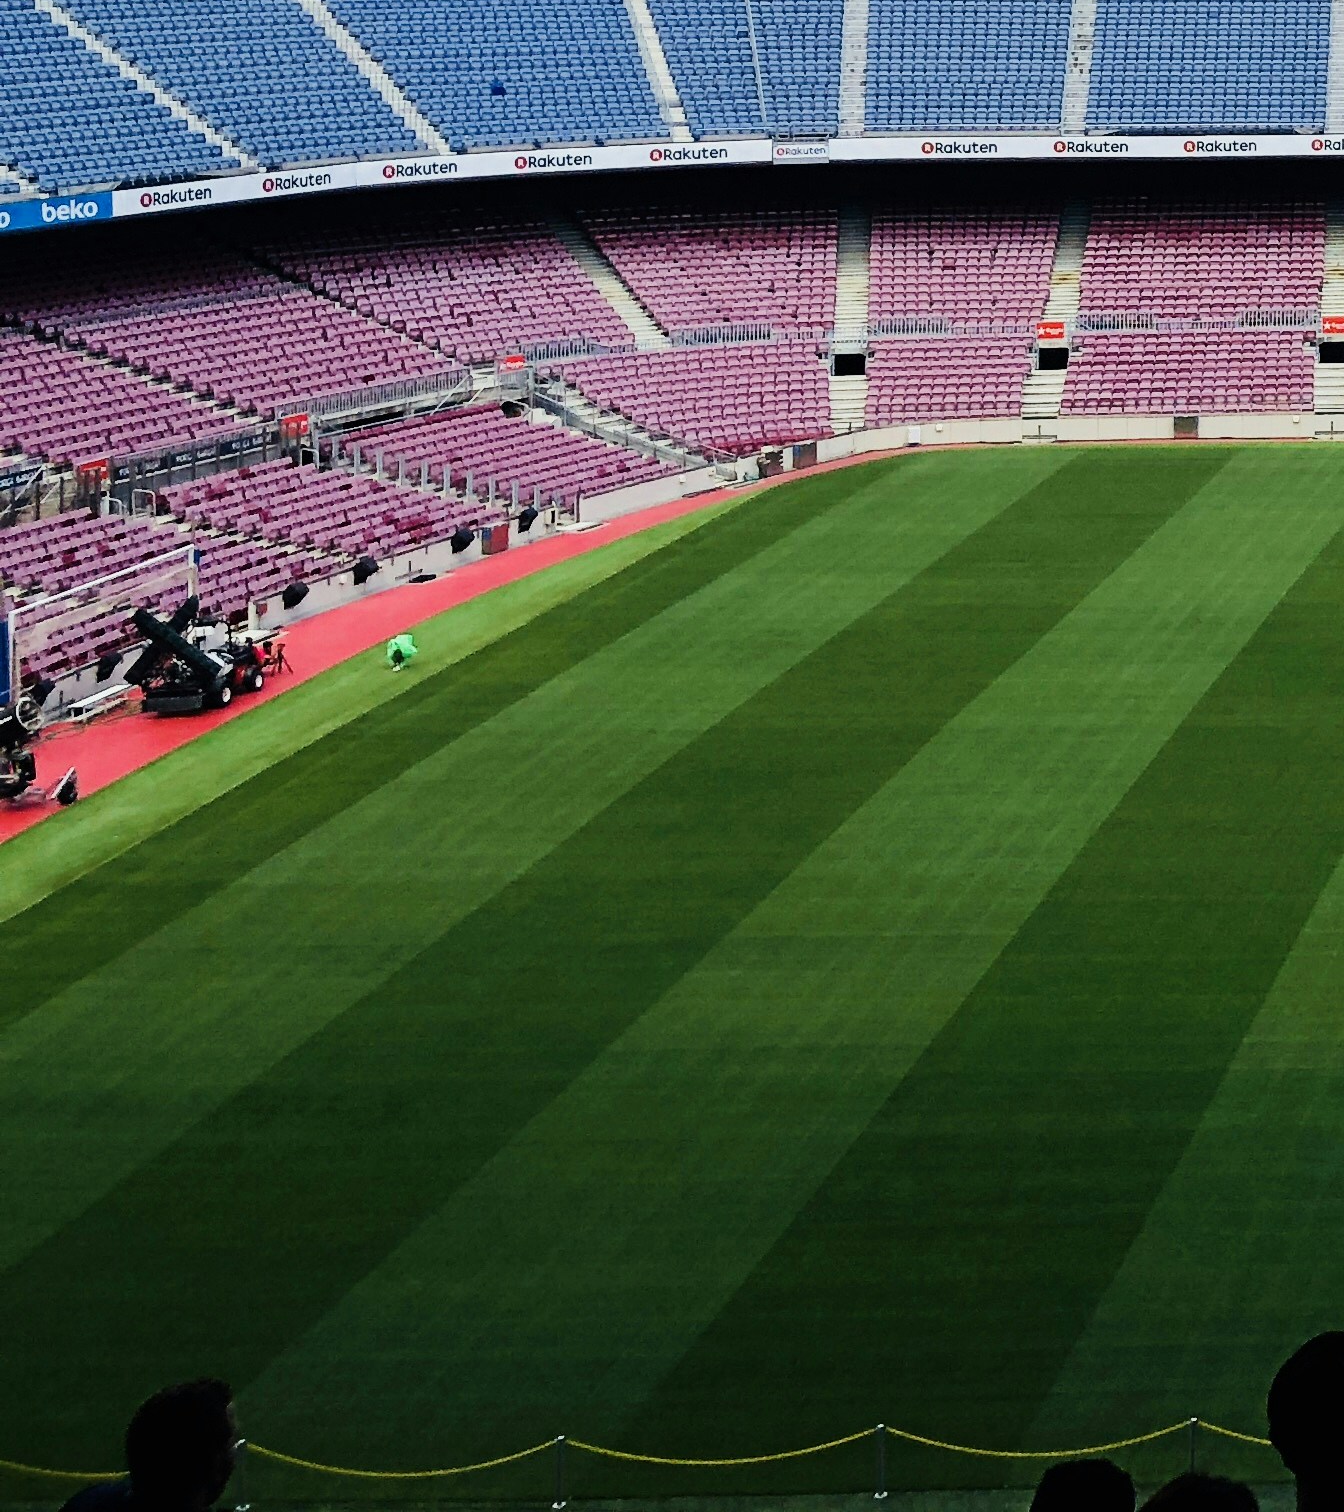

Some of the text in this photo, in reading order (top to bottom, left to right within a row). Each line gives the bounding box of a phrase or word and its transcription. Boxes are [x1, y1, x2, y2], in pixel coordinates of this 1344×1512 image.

[663, 146, 728, 160] Rakuten
[935, 141, 998, 154] Rakuten
[1067, 140, 1129, 154] Rakuten
[1196, 140, 1257, 153] Rakuten
[396, 160, 458, 178] Rakuten
[528, 153, 592, 169] Rakuten
[275, 172, 332, 190] Rakuten
[153, 187, 212, 206] Rakuten
[41, 200, 99, 223] beko
